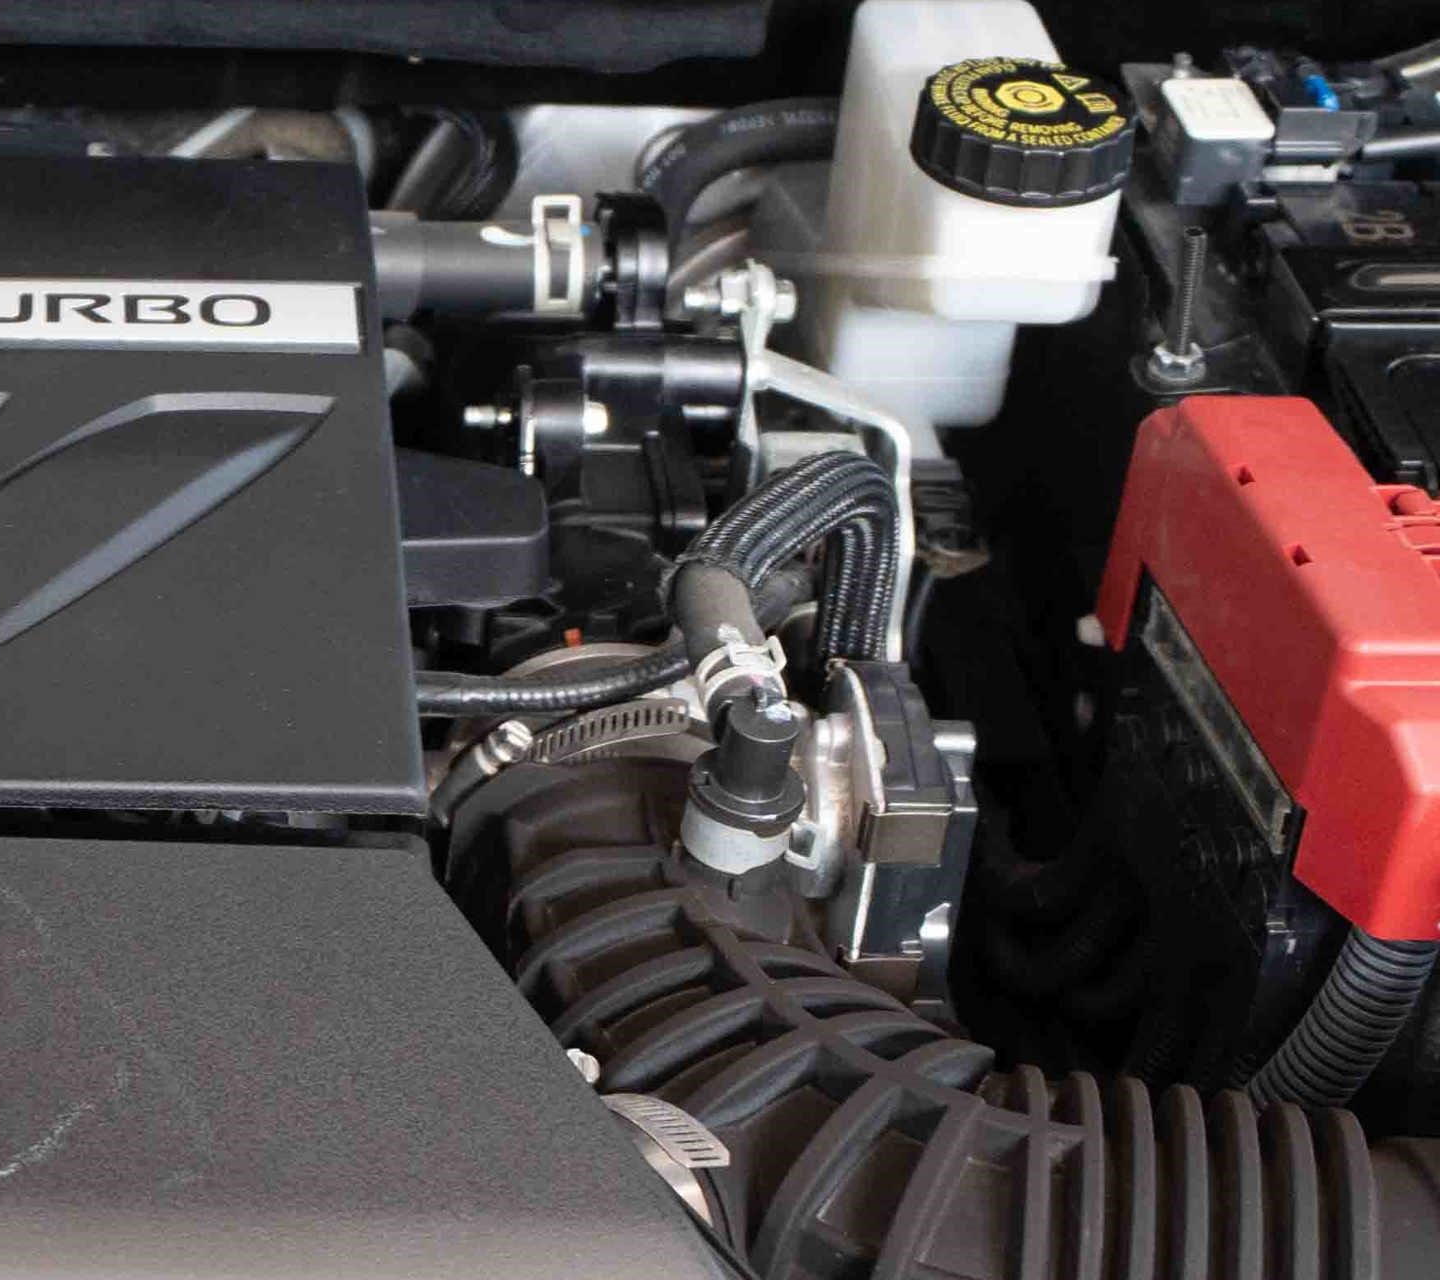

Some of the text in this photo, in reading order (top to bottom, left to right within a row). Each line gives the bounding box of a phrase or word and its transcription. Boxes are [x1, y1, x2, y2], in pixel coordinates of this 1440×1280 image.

[967, 121, 1009, 140] FROM
[1006, 133, 1017, 142] A
[1021, 134, 1074, 146] SEALED
